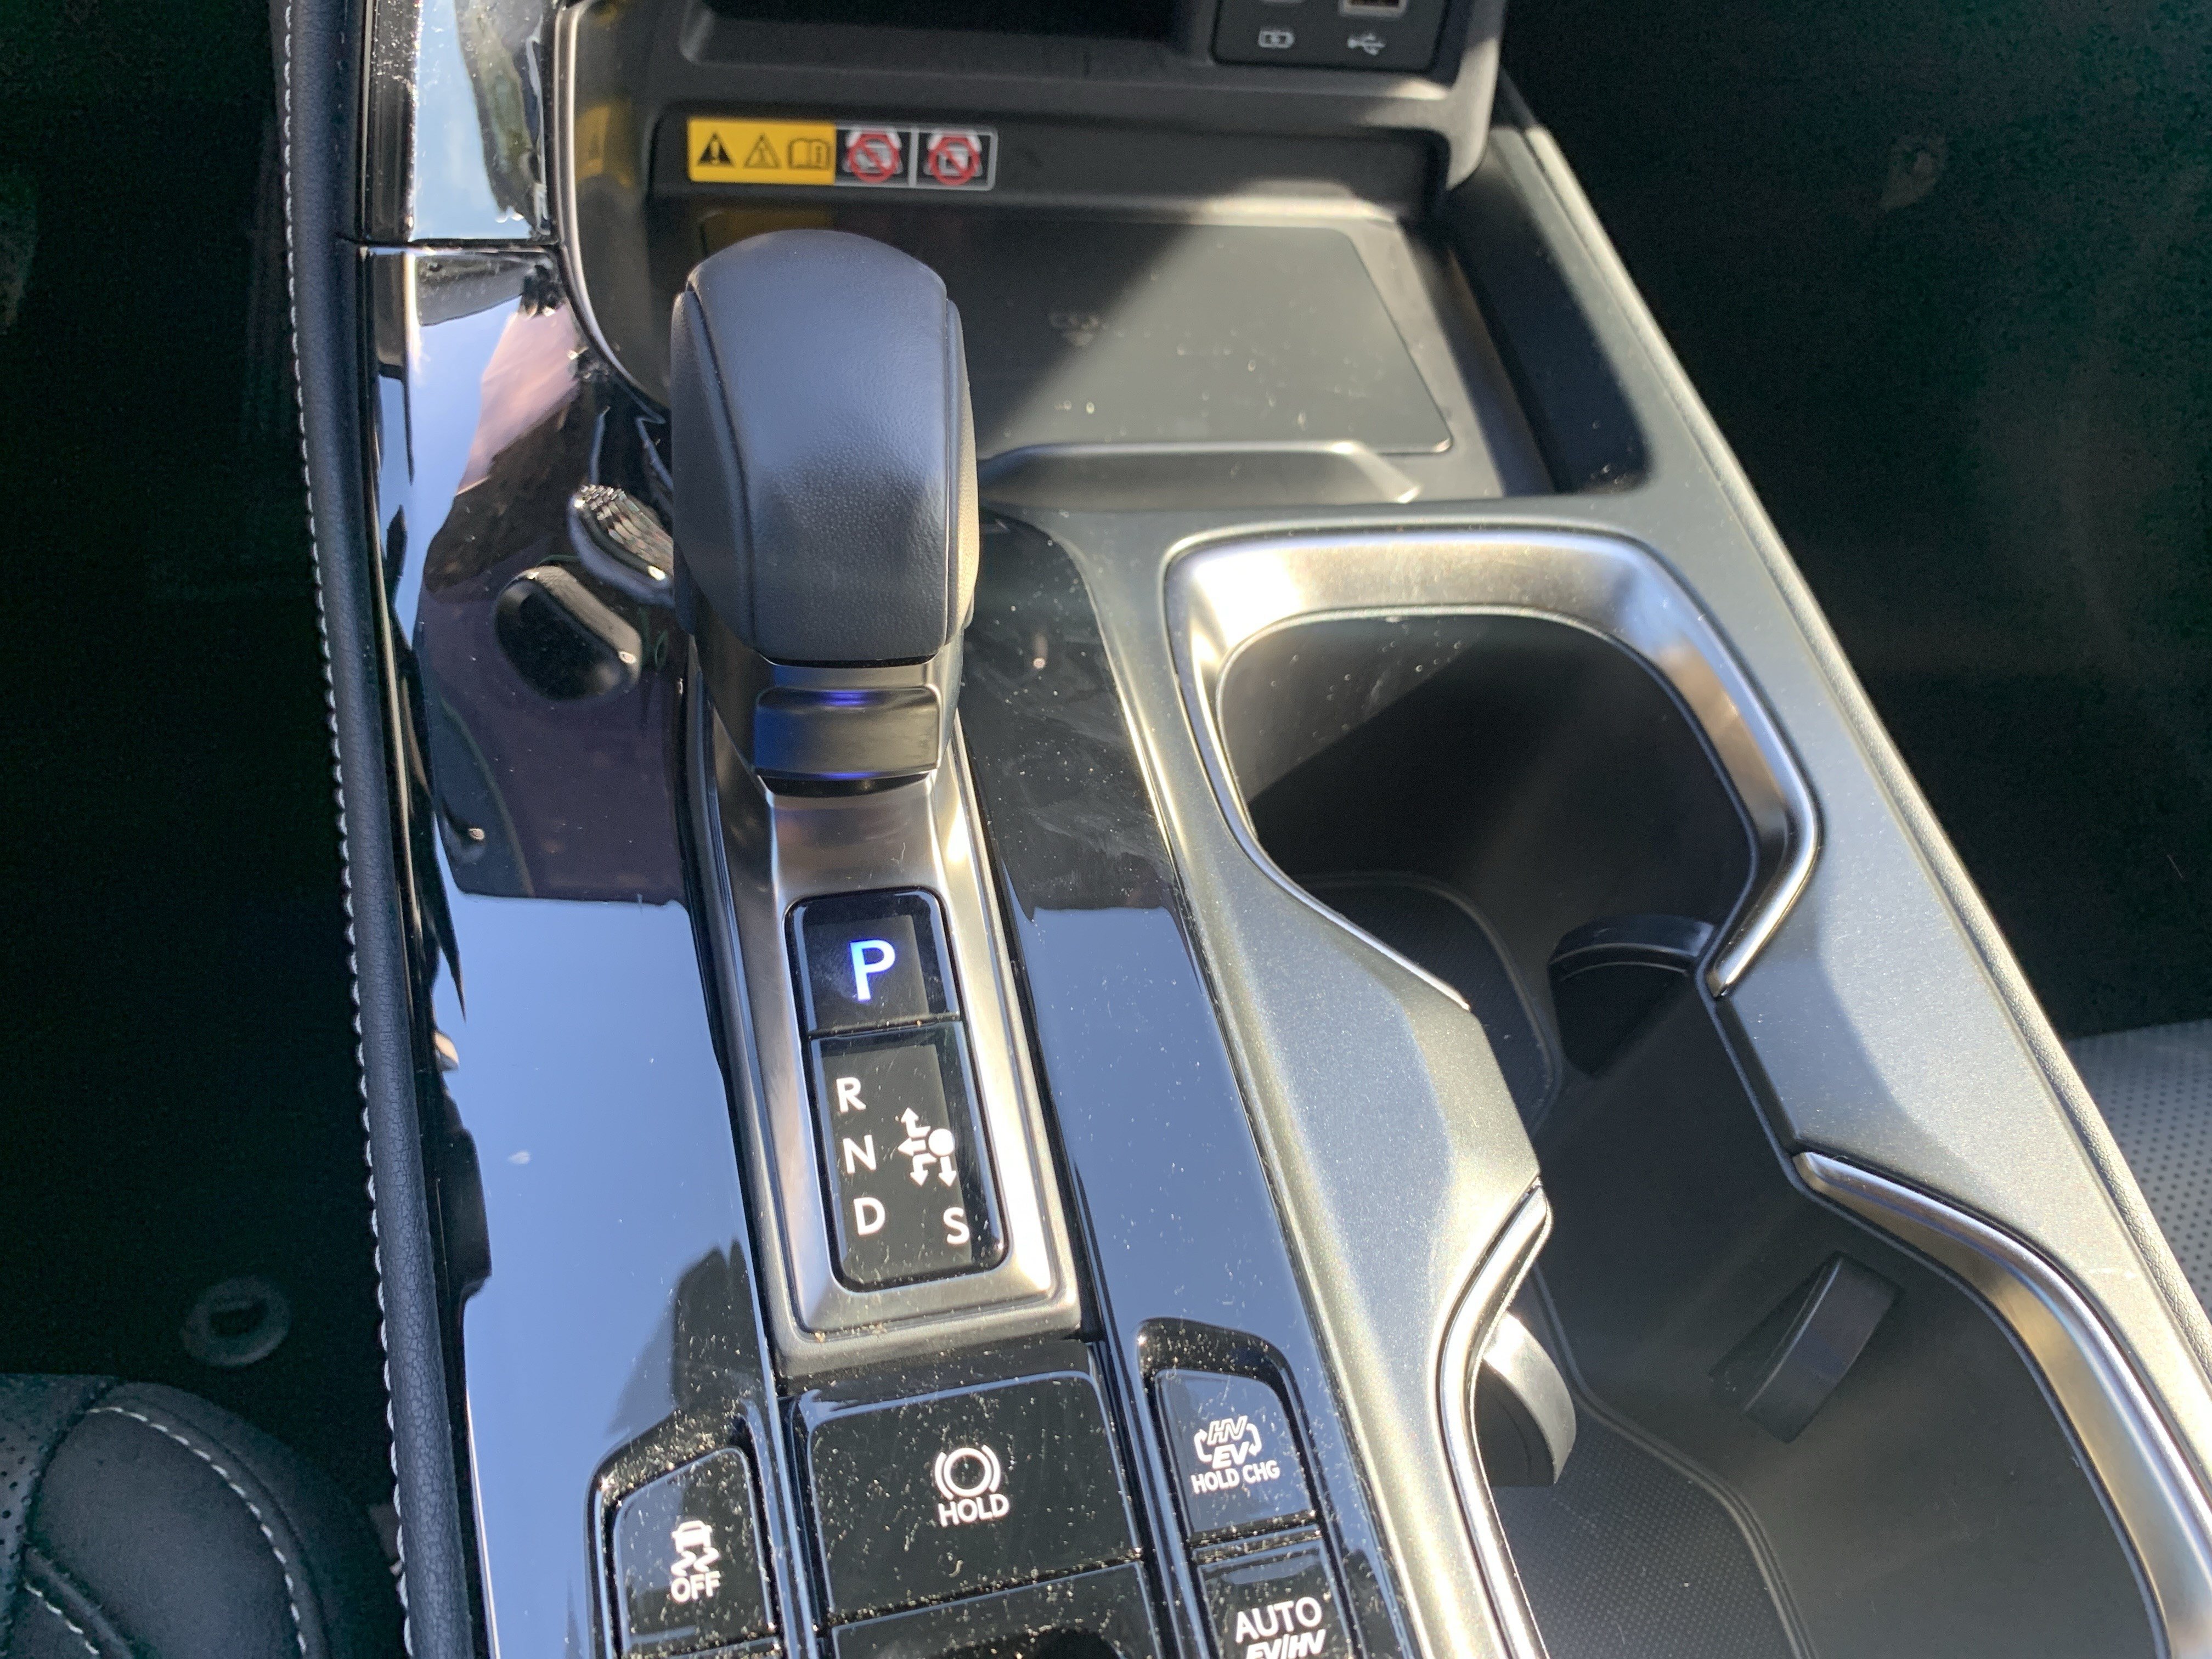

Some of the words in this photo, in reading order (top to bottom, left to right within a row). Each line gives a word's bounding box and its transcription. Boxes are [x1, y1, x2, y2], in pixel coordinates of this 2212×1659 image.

[850, 939, 896, 1000] P
[837, 1077, 866, 1113] R
[843, 1135, 877, 1173] N
[853, 1197, 885, 1235] D
[943, 1207, 970, 1245] S
[1211, 1441, 1250, 1468] EV
[1190, 1469, 1240, 1494] HOLD
[1243, 1460, 1280, 1484] CHG
[938, 1494, 1009, 1527] HOLD
[670, 1571, 720, 1603] OFF
[1235, 1597, 1322, 1643] AUTO
